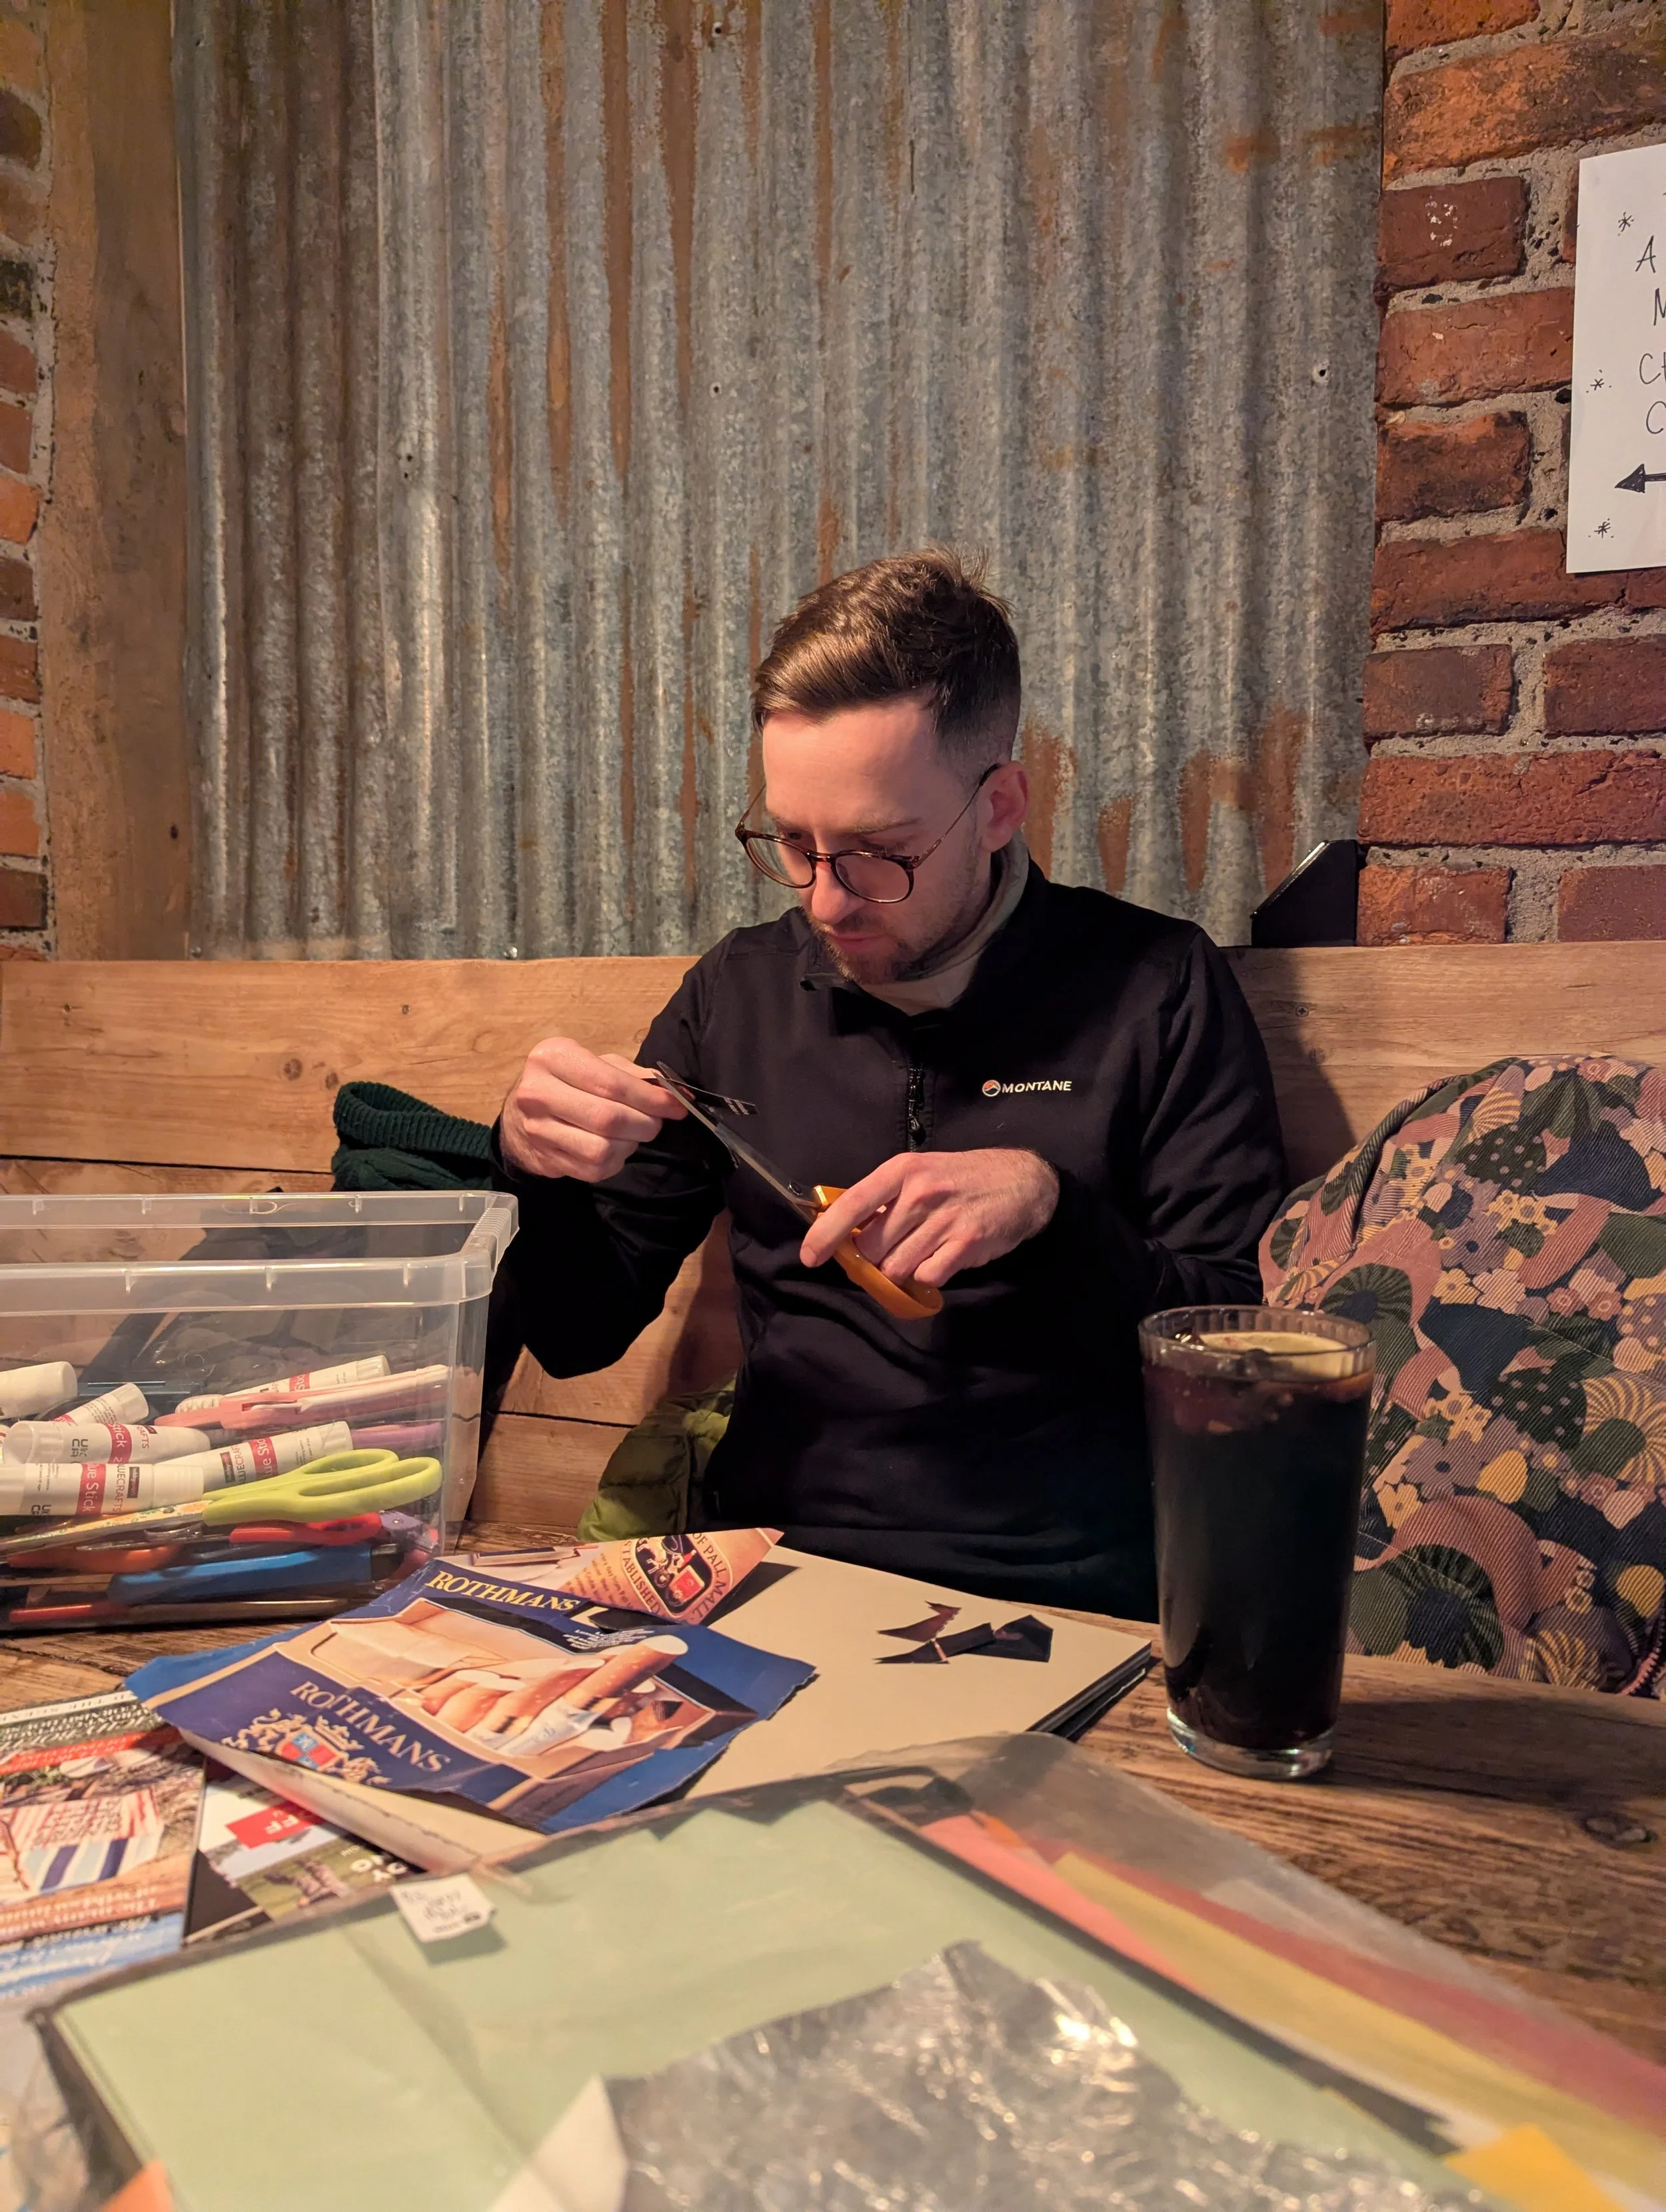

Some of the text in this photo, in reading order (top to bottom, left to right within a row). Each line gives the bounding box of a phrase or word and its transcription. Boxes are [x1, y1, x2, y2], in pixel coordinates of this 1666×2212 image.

[1002, 1080, 1072, 1093] MONTANE
[83, 1482, 99, 1512] Stick
[424, 1570, 580, 1611] ROTHMANS
[692, 1532, 727, 1619] OF PALL MALL
[289, 1681, 452, 1772] ROTHMANS
